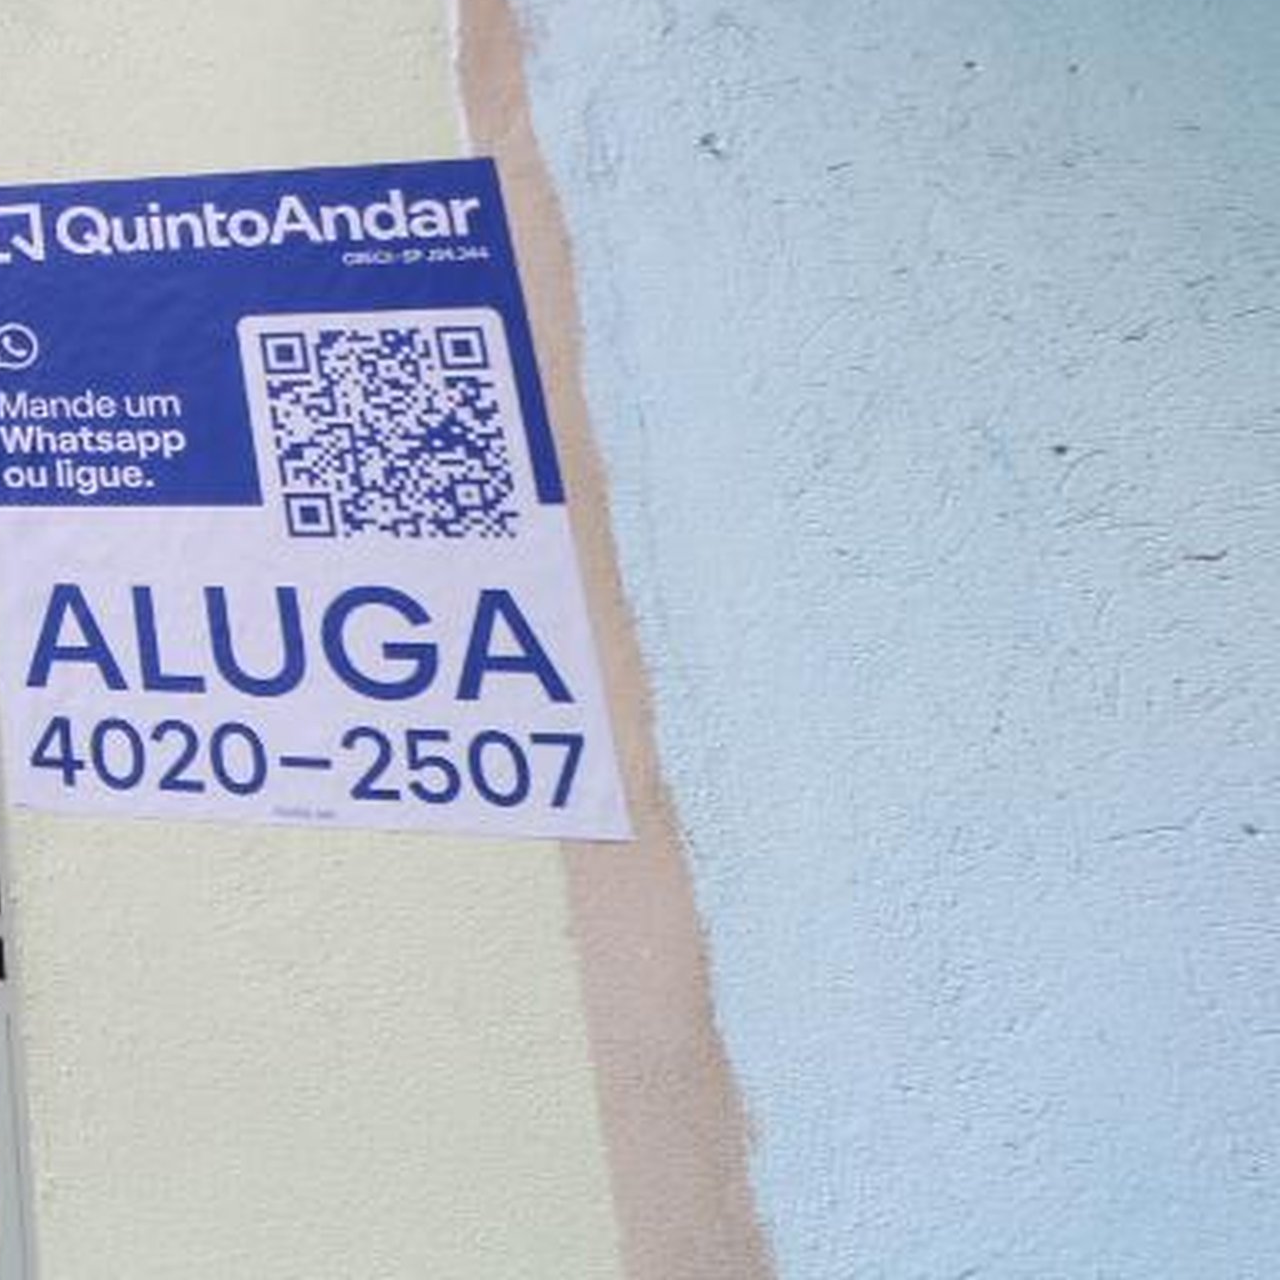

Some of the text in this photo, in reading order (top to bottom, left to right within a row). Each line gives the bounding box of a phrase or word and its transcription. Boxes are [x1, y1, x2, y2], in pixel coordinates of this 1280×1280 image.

[54, 188, 481, 256] QuintoAndar
[124, 394, 182, 418] um
[2, 458, 156, 496] ou ligue.
[25, 582, 575, 703] ALUGA
[30, 716, 585, 809] 4020-2507
